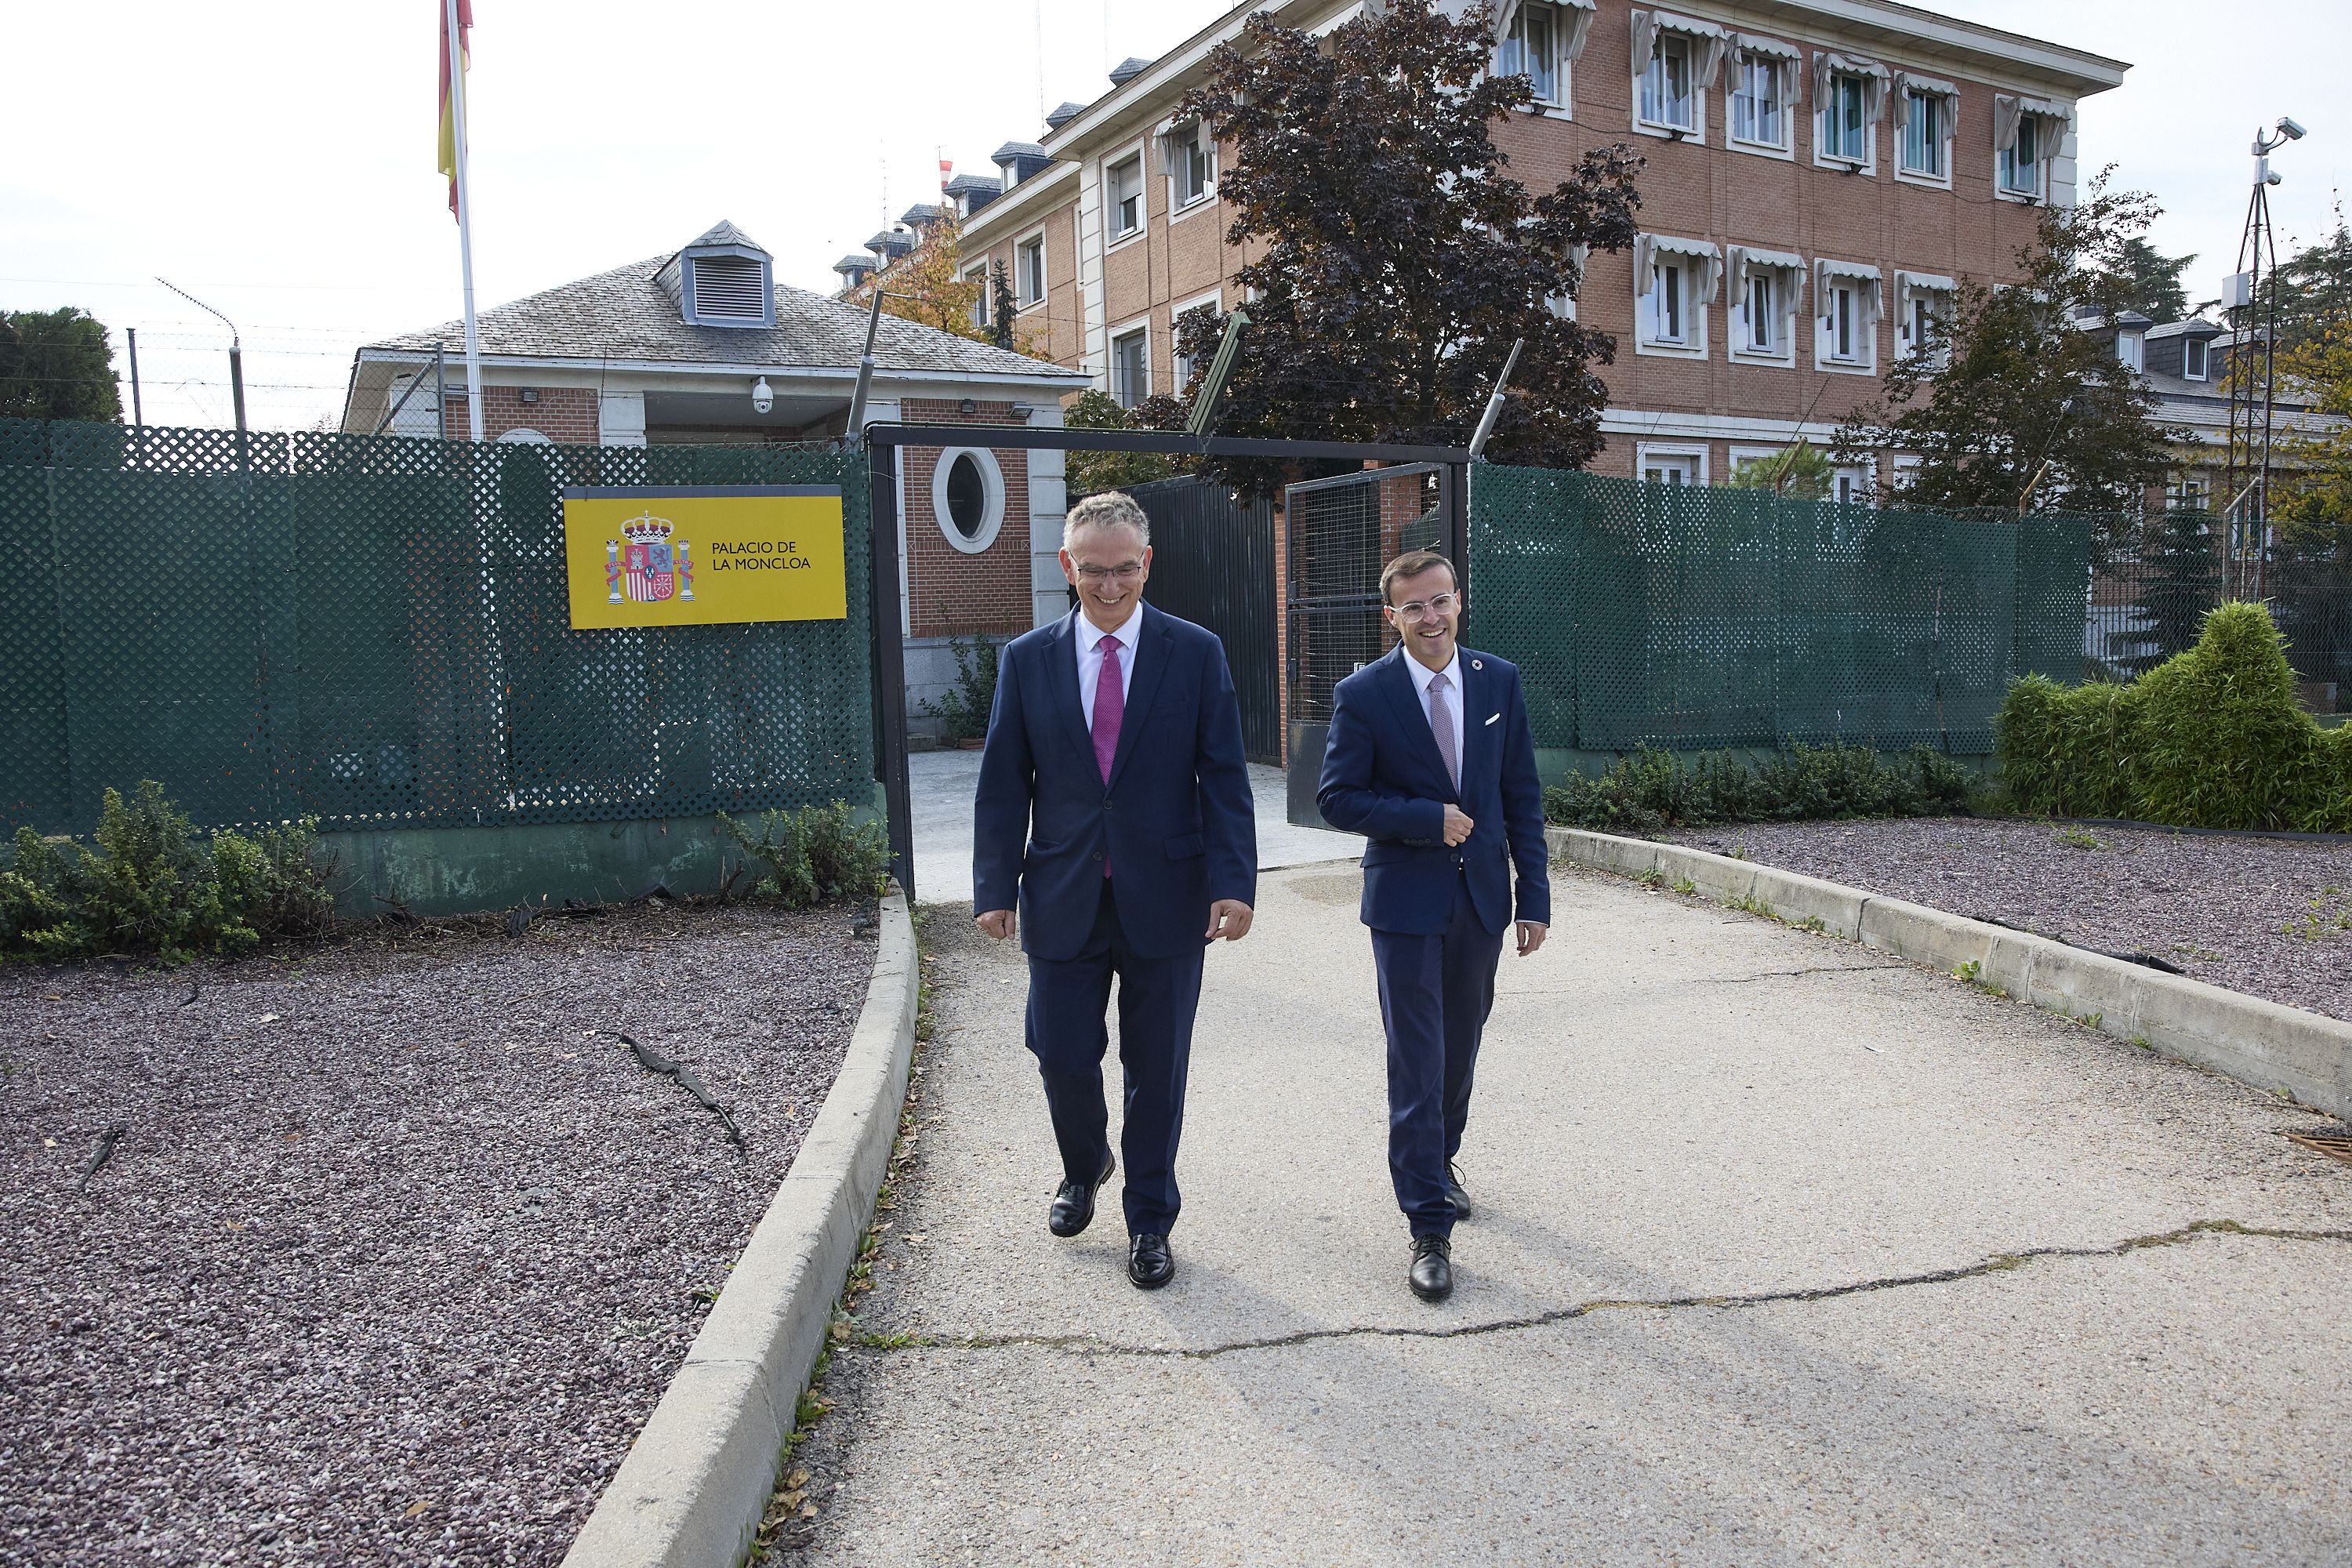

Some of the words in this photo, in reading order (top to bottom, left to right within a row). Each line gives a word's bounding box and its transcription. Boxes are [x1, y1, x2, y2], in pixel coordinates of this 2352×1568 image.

[712, 542, 773, 554] PALACIO
[778, 541, 797, 553] DE
[713, 559, 731, 570] LA
[735, 557, 811, 570] MONCLOA
